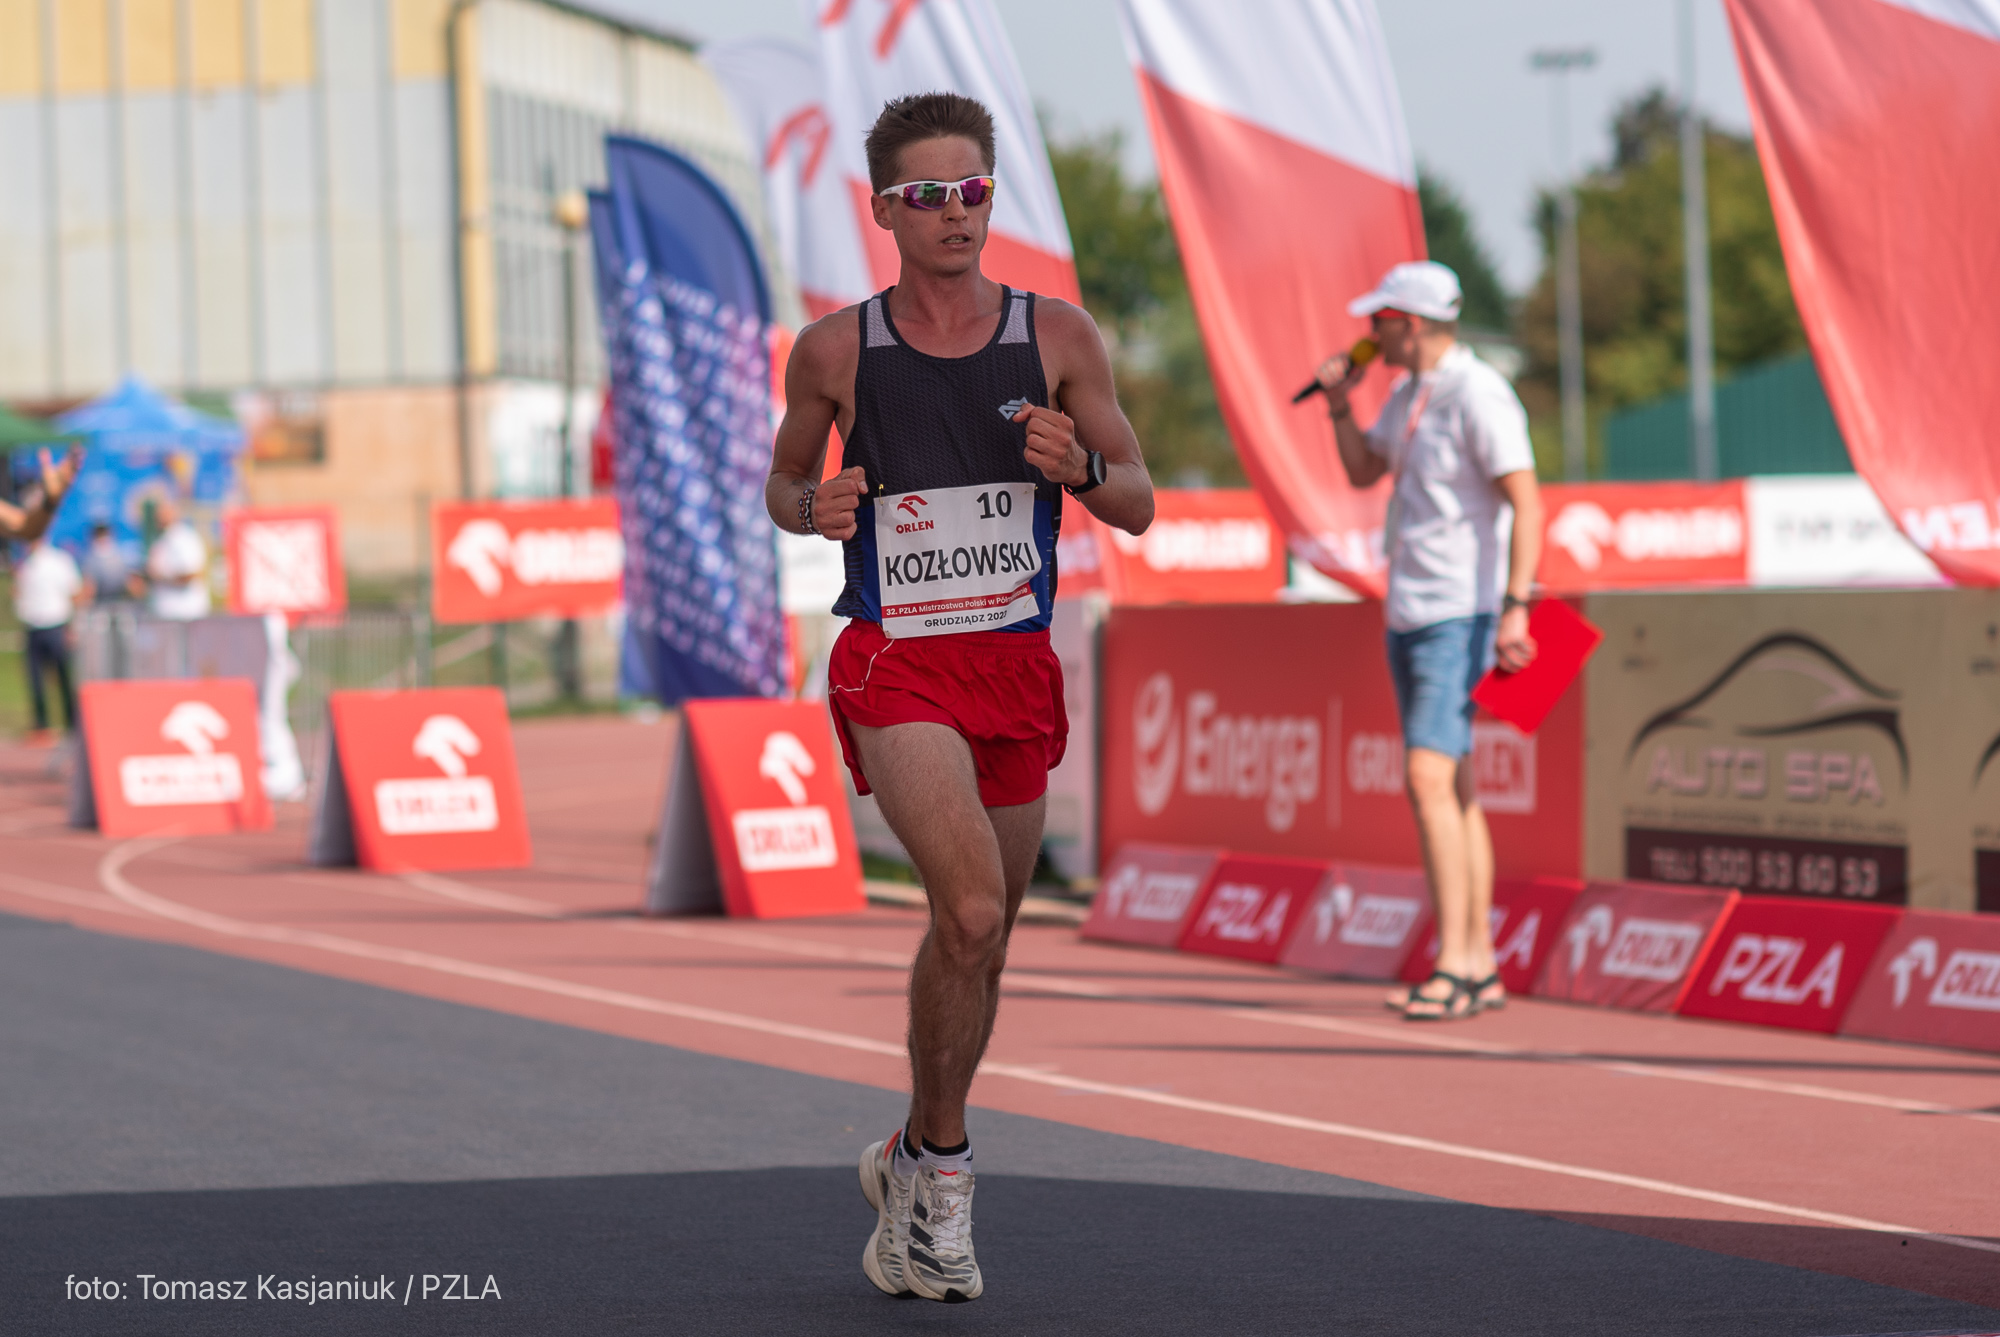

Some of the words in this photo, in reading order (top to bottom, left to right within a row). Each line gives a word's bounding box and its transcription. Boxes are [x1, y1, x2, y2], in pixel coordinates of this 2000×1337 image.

[895, 520, 934, 534] ORLEN
[976, 490, 1012, 520] 10
[885, 542, 1035, 586] KOZŁOWSKI
[886, 608, 898, 616] 32.
[899, 606, 918, 615] PZLA
[919, 602, 964, 613] Mistrzostwa
[965, 599, 987, 608] Polski
[924, 614, 985, 628] GRUDZIĄDZ
[1183, 693, 1321, 831] Energa
[1648, 747, 1766, 797] AUTO
[1785, 751, 1883, 805] SPA
[1197, 882, 1292, 942] PZLA
[1709, 933, 1846, 1008] PZLA
